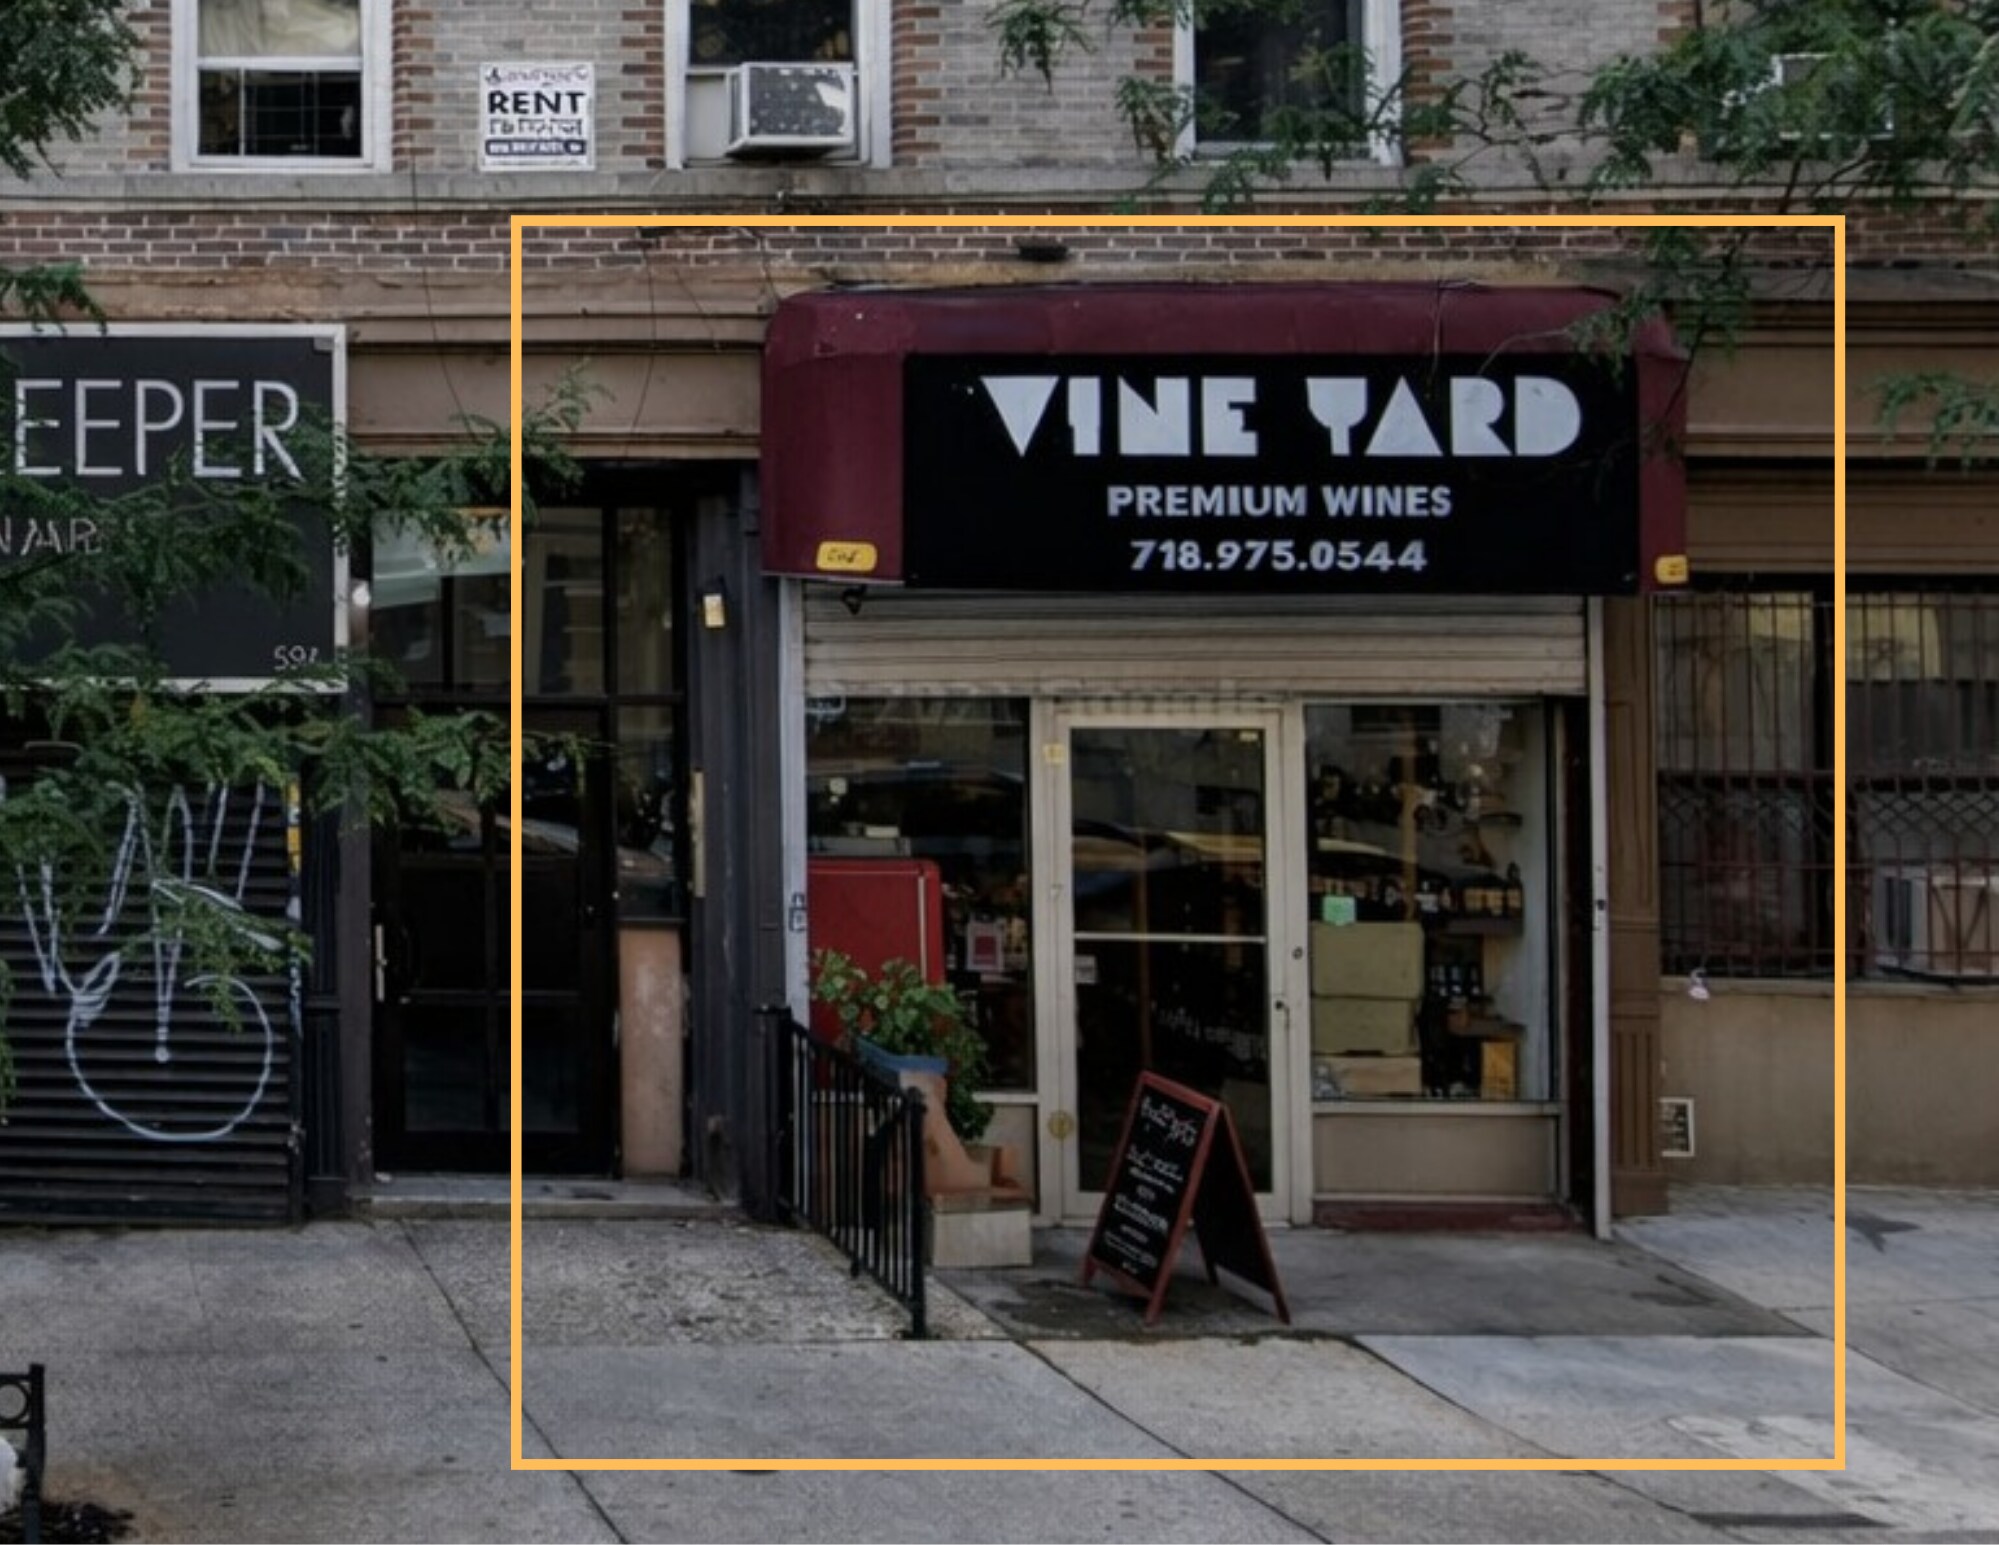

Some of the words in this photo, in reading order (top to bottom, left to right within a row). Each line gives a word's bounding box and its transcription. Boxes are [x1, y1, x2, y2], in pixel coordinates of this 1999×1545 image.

[488, 90, 586, 115] RENT
[0, 378, 303, 479] EEPER
[980, 375, 1258, 457] VINE
[1306, 375, 1582, 457] YARD
[1107, 485, 1306, 517] PREMIUM
[1322, 485, 1452, 517] WINES
[1130, 538, 1427, 571] 718.975.0544
